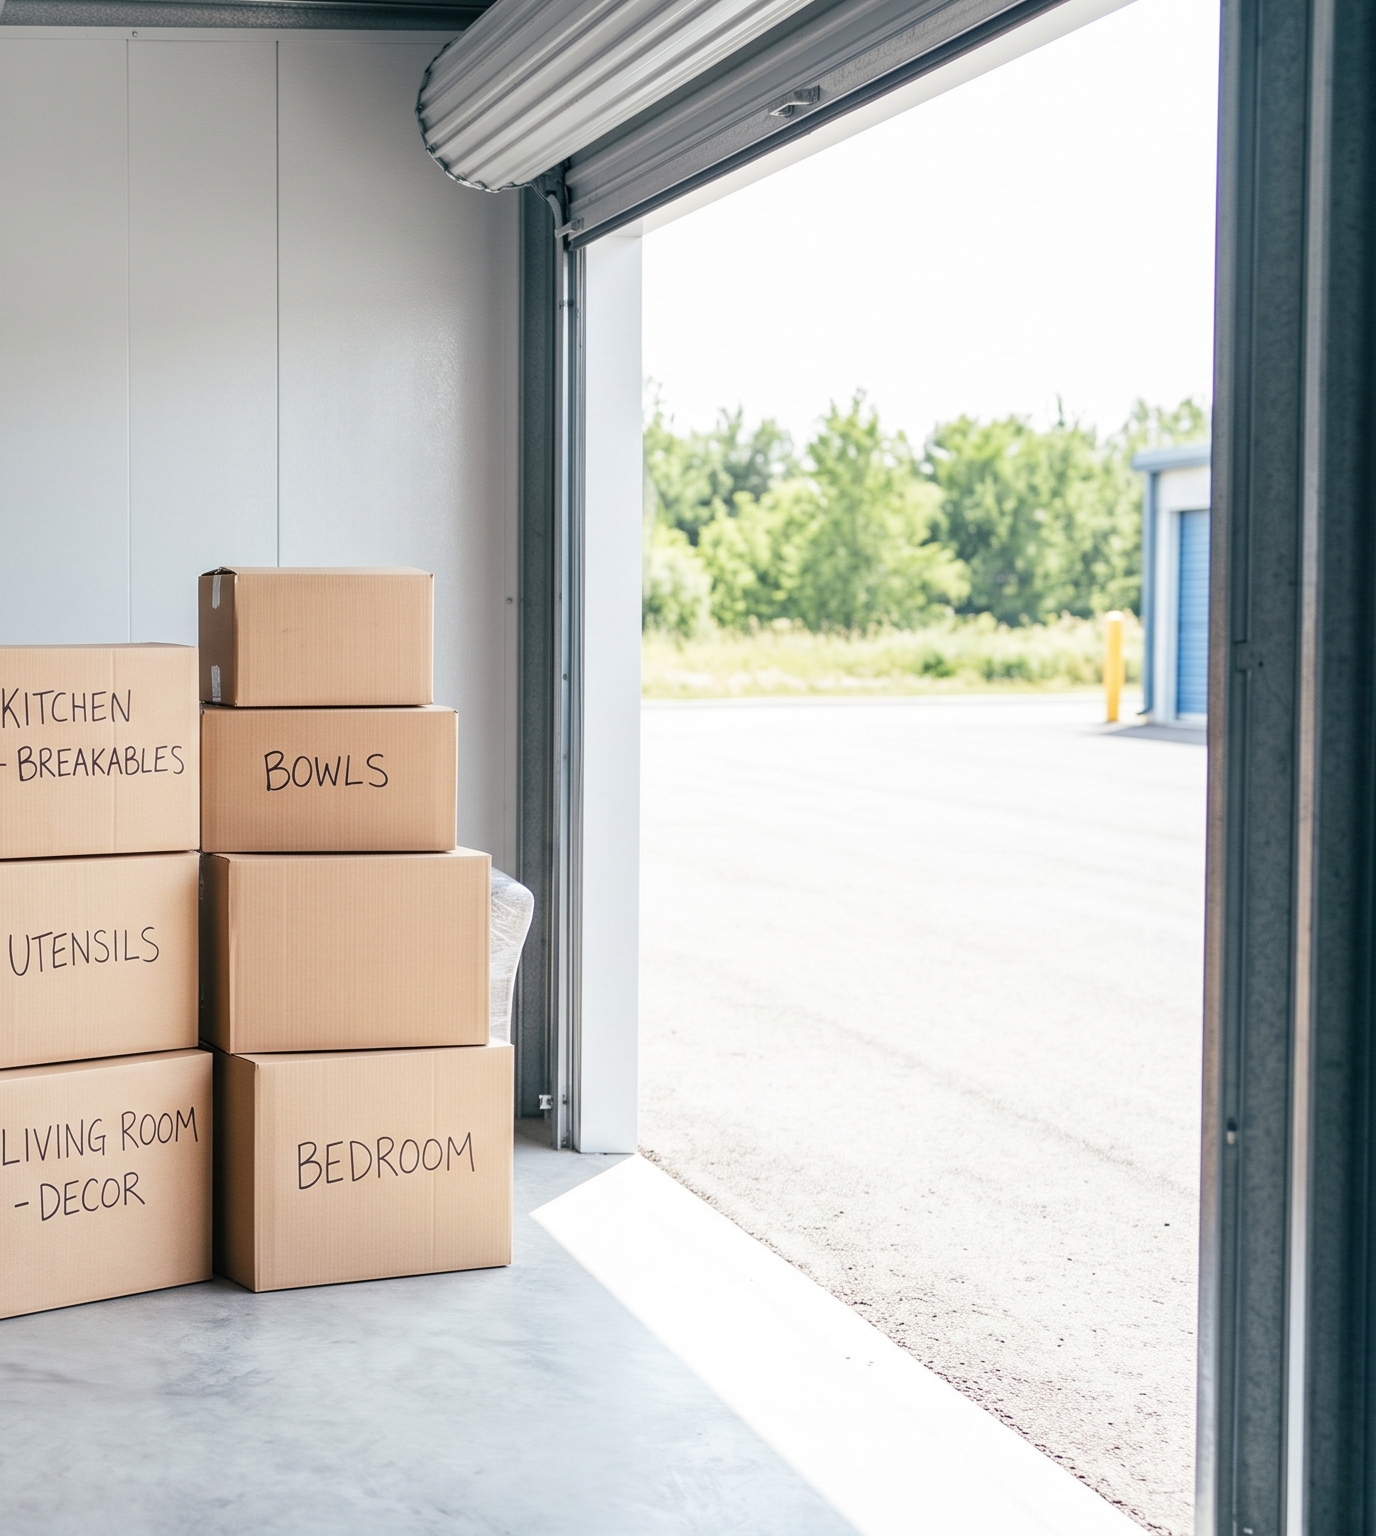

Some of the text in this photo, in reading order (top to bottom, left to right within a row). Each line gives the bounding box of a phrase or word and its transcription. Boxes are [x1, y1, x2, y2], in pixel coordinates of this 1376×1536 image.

[1, 687, 132, 729] KITCHEN
[263, 750, 390, 792] BOWLS
[8, 926, 160, 977] UTENSILS
[1, 1106, 199, 1167] LIVING ROOM
[297, 1131, 476, 1191] BEDROOM
